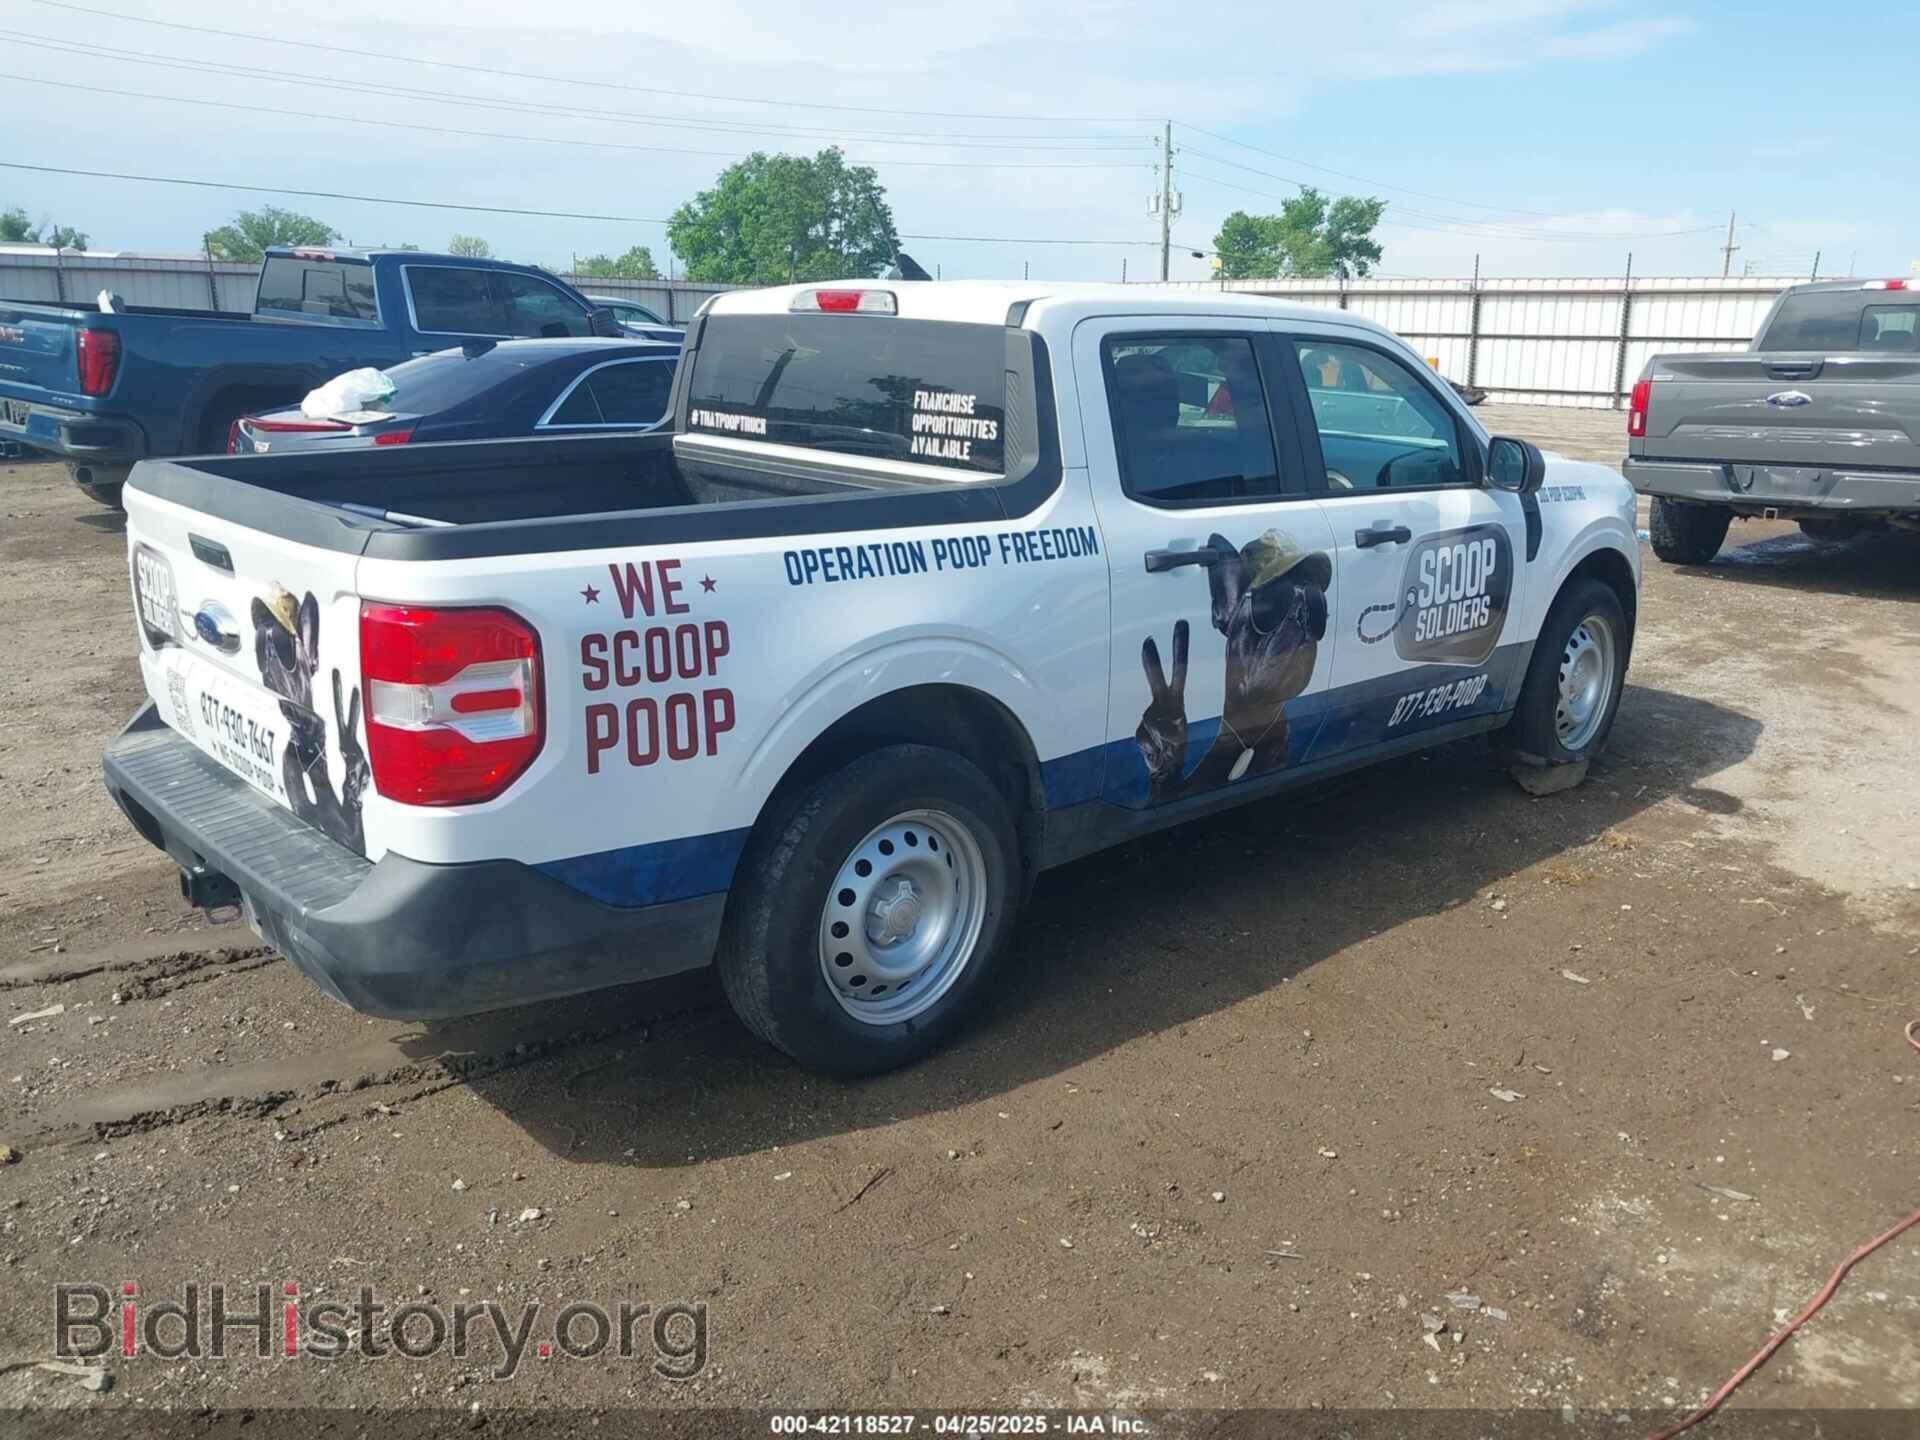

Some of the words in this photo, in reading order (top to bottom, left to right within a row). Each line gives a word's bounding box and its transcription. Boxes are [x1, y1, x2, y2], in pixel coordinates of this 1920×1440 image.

[912, 413, 998, 440] OPPORTUNITIES
[913, 390, 977, 414] FRANCHISE
[911, 435, 972, 461] AVAILABLE
[783, 540, 928, 586] OPERATION
[931, 535, 992, 571] POOP
[997, 526, 1099, 564] FREEDOM
[1417, 538, 1496, 609] SCOOP
[608, 558, 690, 619] WE
[1415, 595, 1490, 642] SOLDIERS
[580, 620, 730, 691] SCOOP
[200, 691, 275, 766] 877-930-7667
[1387, 673, 1488, 727] 877-930-POOP
[585, 687, 736, 775] POOP
